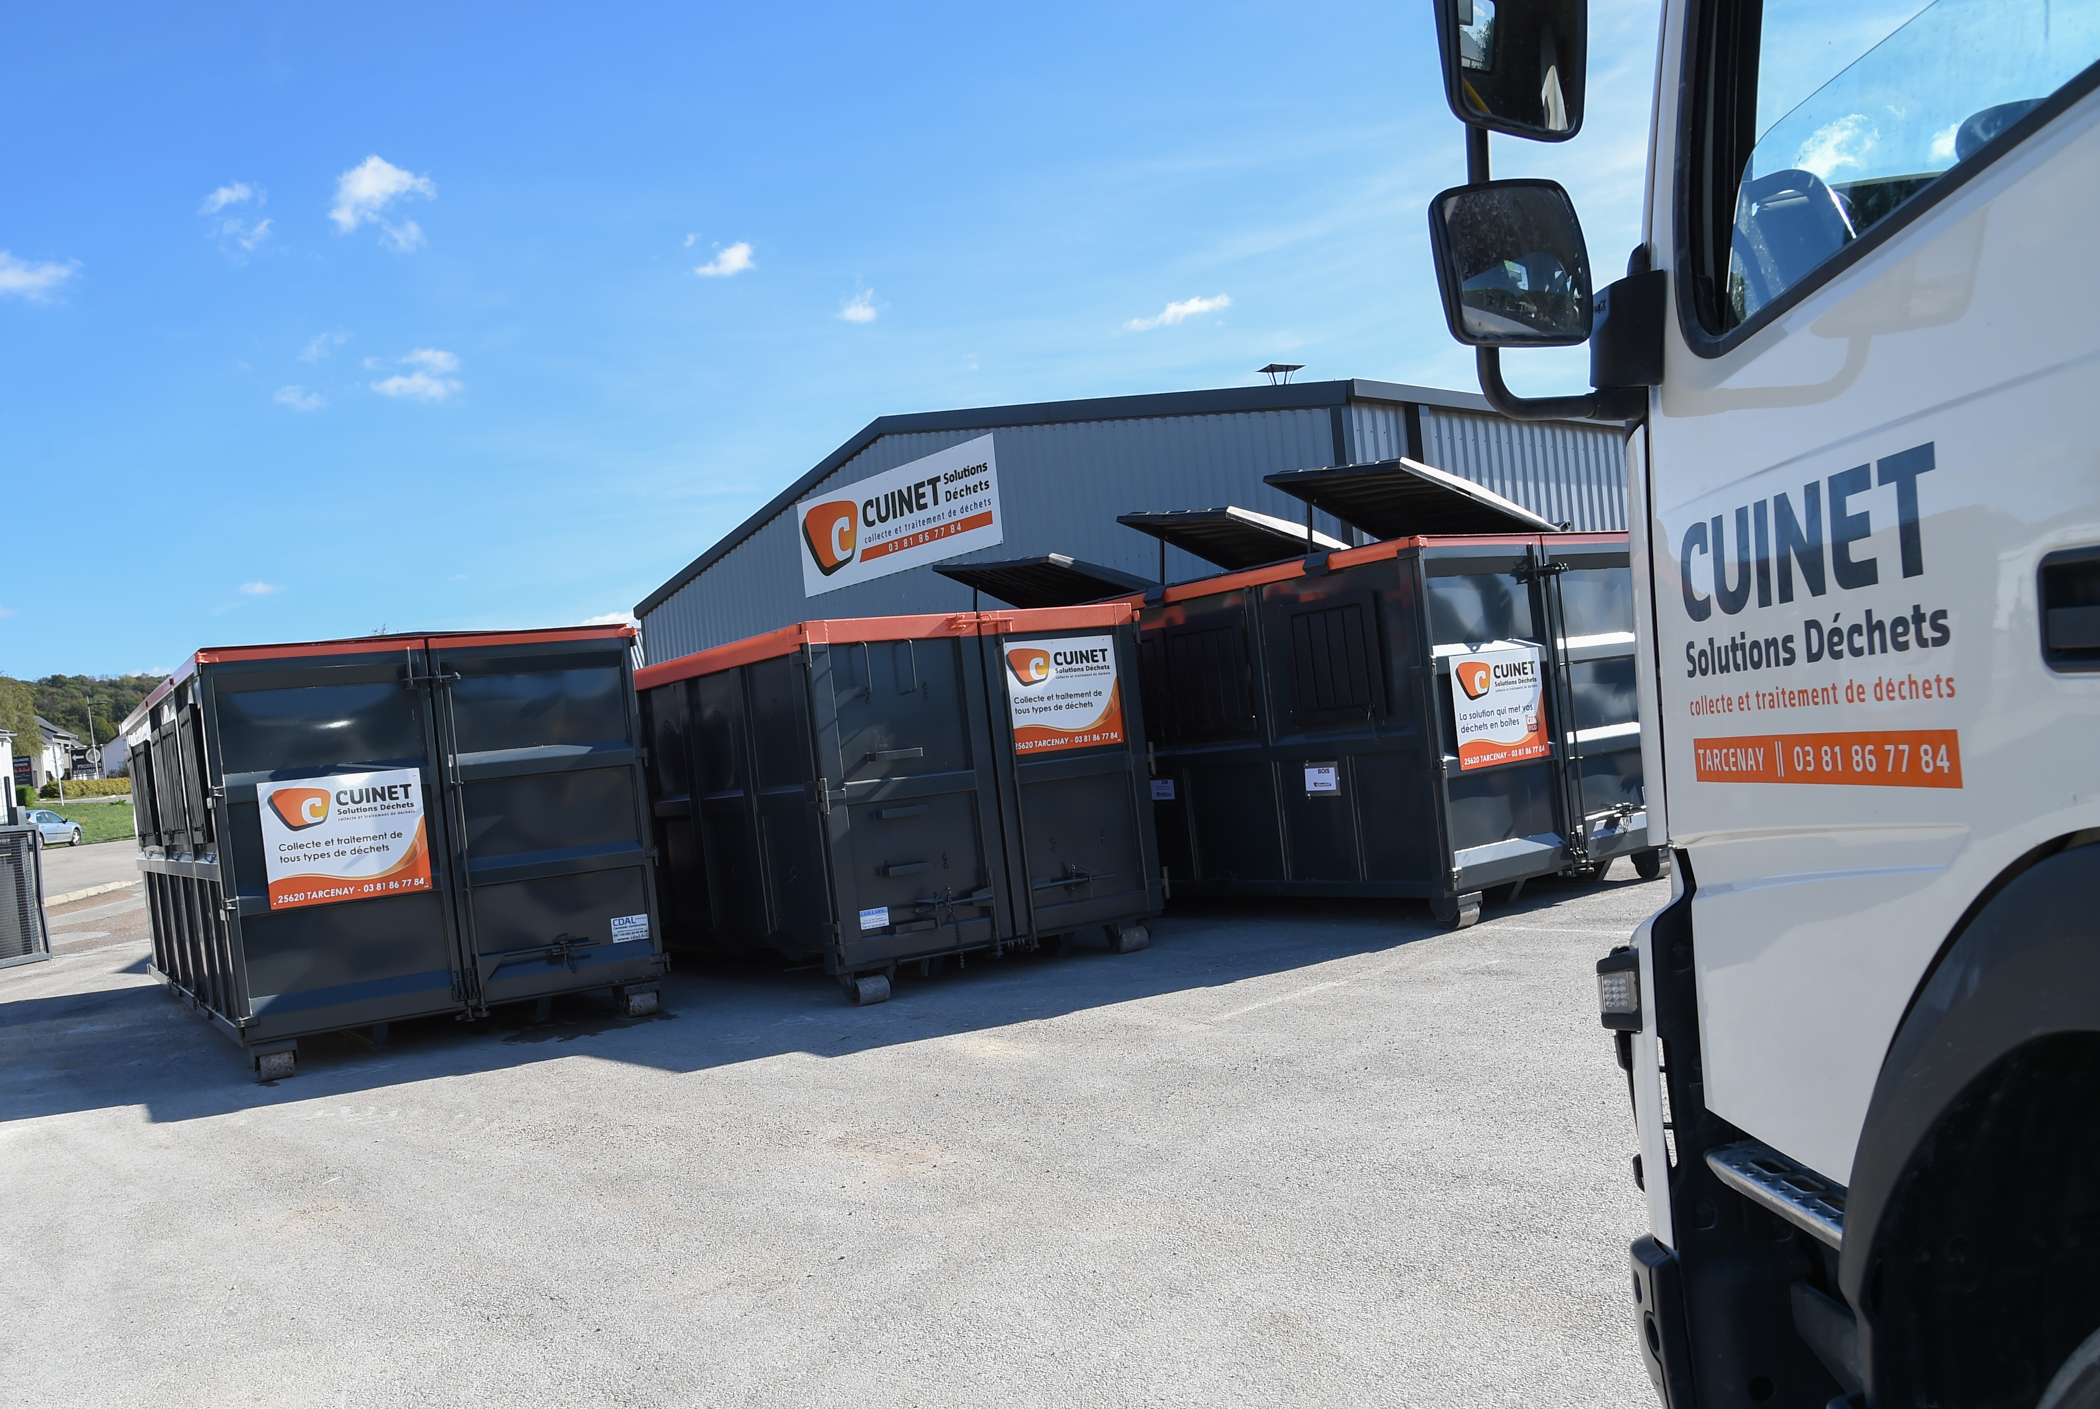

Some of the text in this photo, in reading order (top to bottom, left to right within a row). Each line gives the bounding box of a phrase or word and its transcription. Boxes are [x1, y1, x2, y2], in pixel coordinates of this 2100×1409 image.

[944, 462, 988, 484] Solutions
[862, 476, 941, 527] CUINET
[945, 480, 989, 502] Déchets
[865, 499, 991, 543] collecte et traitement de déchets
[1680, 441, 1936, 622] CUINET
[889, 523, 962, 551] 03 81 86 77 84
[1686, 604, 1950, 678] Solutions Déchets
[1054, 649, 1107, 666] CUINET
[1494, 661, 1535, 678] CUINET
[1014, 695, 1044, 704] Collecte
[1056, 690, 1091, 700] traitement
[1689, 674, 1955, 716] collecte et traitement de déchets
[1032, 705, 1051, 714] types
[1065, 700, 1093, 709] déchets
[1469, 709, 1494, 719] solution
[1497, 707, 1506, 716] qui
[1508, 705, 1520, 714] met
[1461, 722, 1488, 733] déchets
[1500, 718, 1519, 727] boîtes
[1034, 738, 1069, 747] TARCENAY
[1464, 757, 1479, 765] 25620
[1480, 752, 1507, 762] TARCENAY
[1698, 744, 1950, 773] TARCENAY 03 81 86 77 84
[336, 784, 411, 806] CUINET
[337, 802, 414, 815] Solutions Déchets
[279, 841, 321, 852] Collecte
[337, 832, 387, 845] traitement
[390, 831, 403, 839] de
[280, 844, 389, 863] tous types de déchets
[278, 893, 304, 904] 25620
[307, 887, 355, 900] TARCENAY
[364, 884, 374, 892] 03
[376, 882, 386, 891] 81
[414, 877, 424, 886] 84
[613, 917, 636, 926] CDAL
